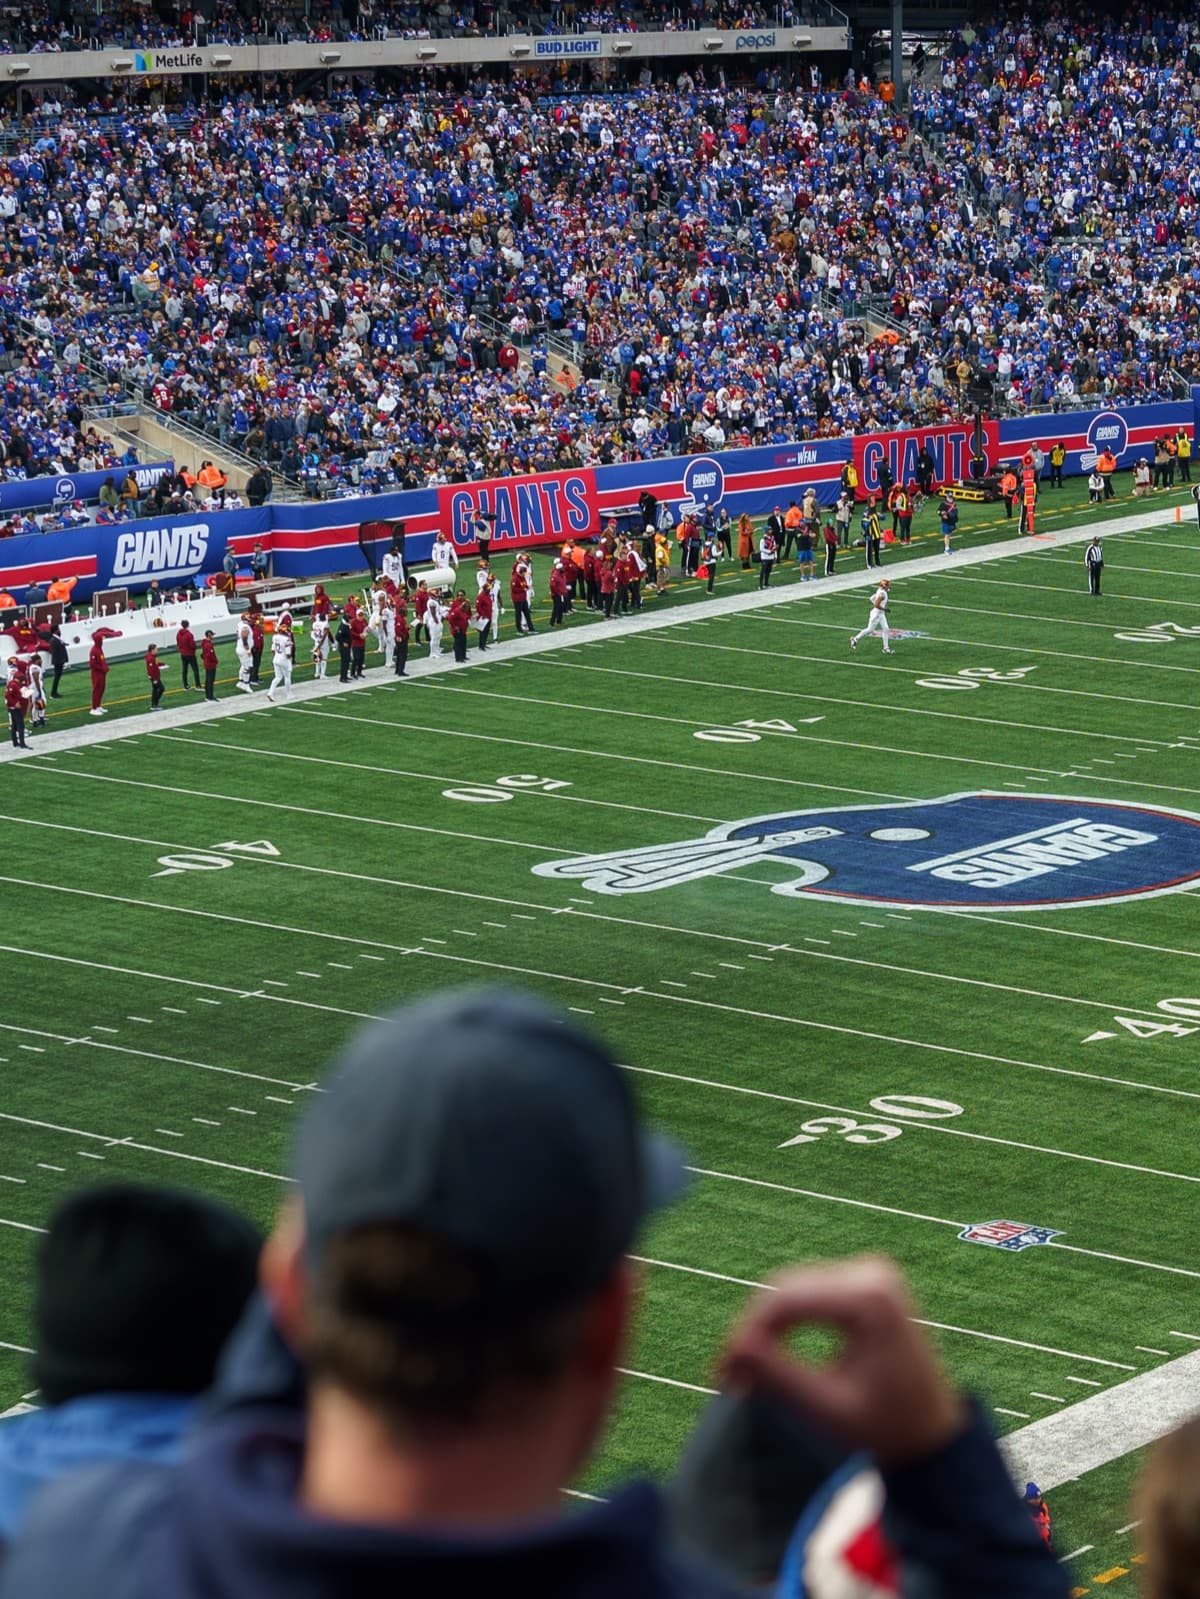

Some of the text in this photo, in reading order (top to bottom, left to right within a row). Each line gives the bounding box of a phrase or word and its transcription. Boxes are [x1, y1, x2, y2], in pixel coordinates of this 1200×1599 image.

[537, 40, 599, 54] BUD LIGHT
[736, 32, 776, 50] pepsi
[155, 54, 203, 68] MetLife
[1096, 425, 1120, 438] GIANTS
[797, 445, 818, 464] WFAN
[863, 430, 990, 492] GIANTS
[692, 472, 716, 485] GIANTS
[451, 476, 591, 545] GIANTS
[113, 523, 210, 576] GIANTS
[692, 717, 798, 744] 40
[440, 774, 574, 802] 50
[156, 838, 281, 871] 40
[929, 822, 1160, 889] GIANTS
[800, 1094, 965, 1145] 30
